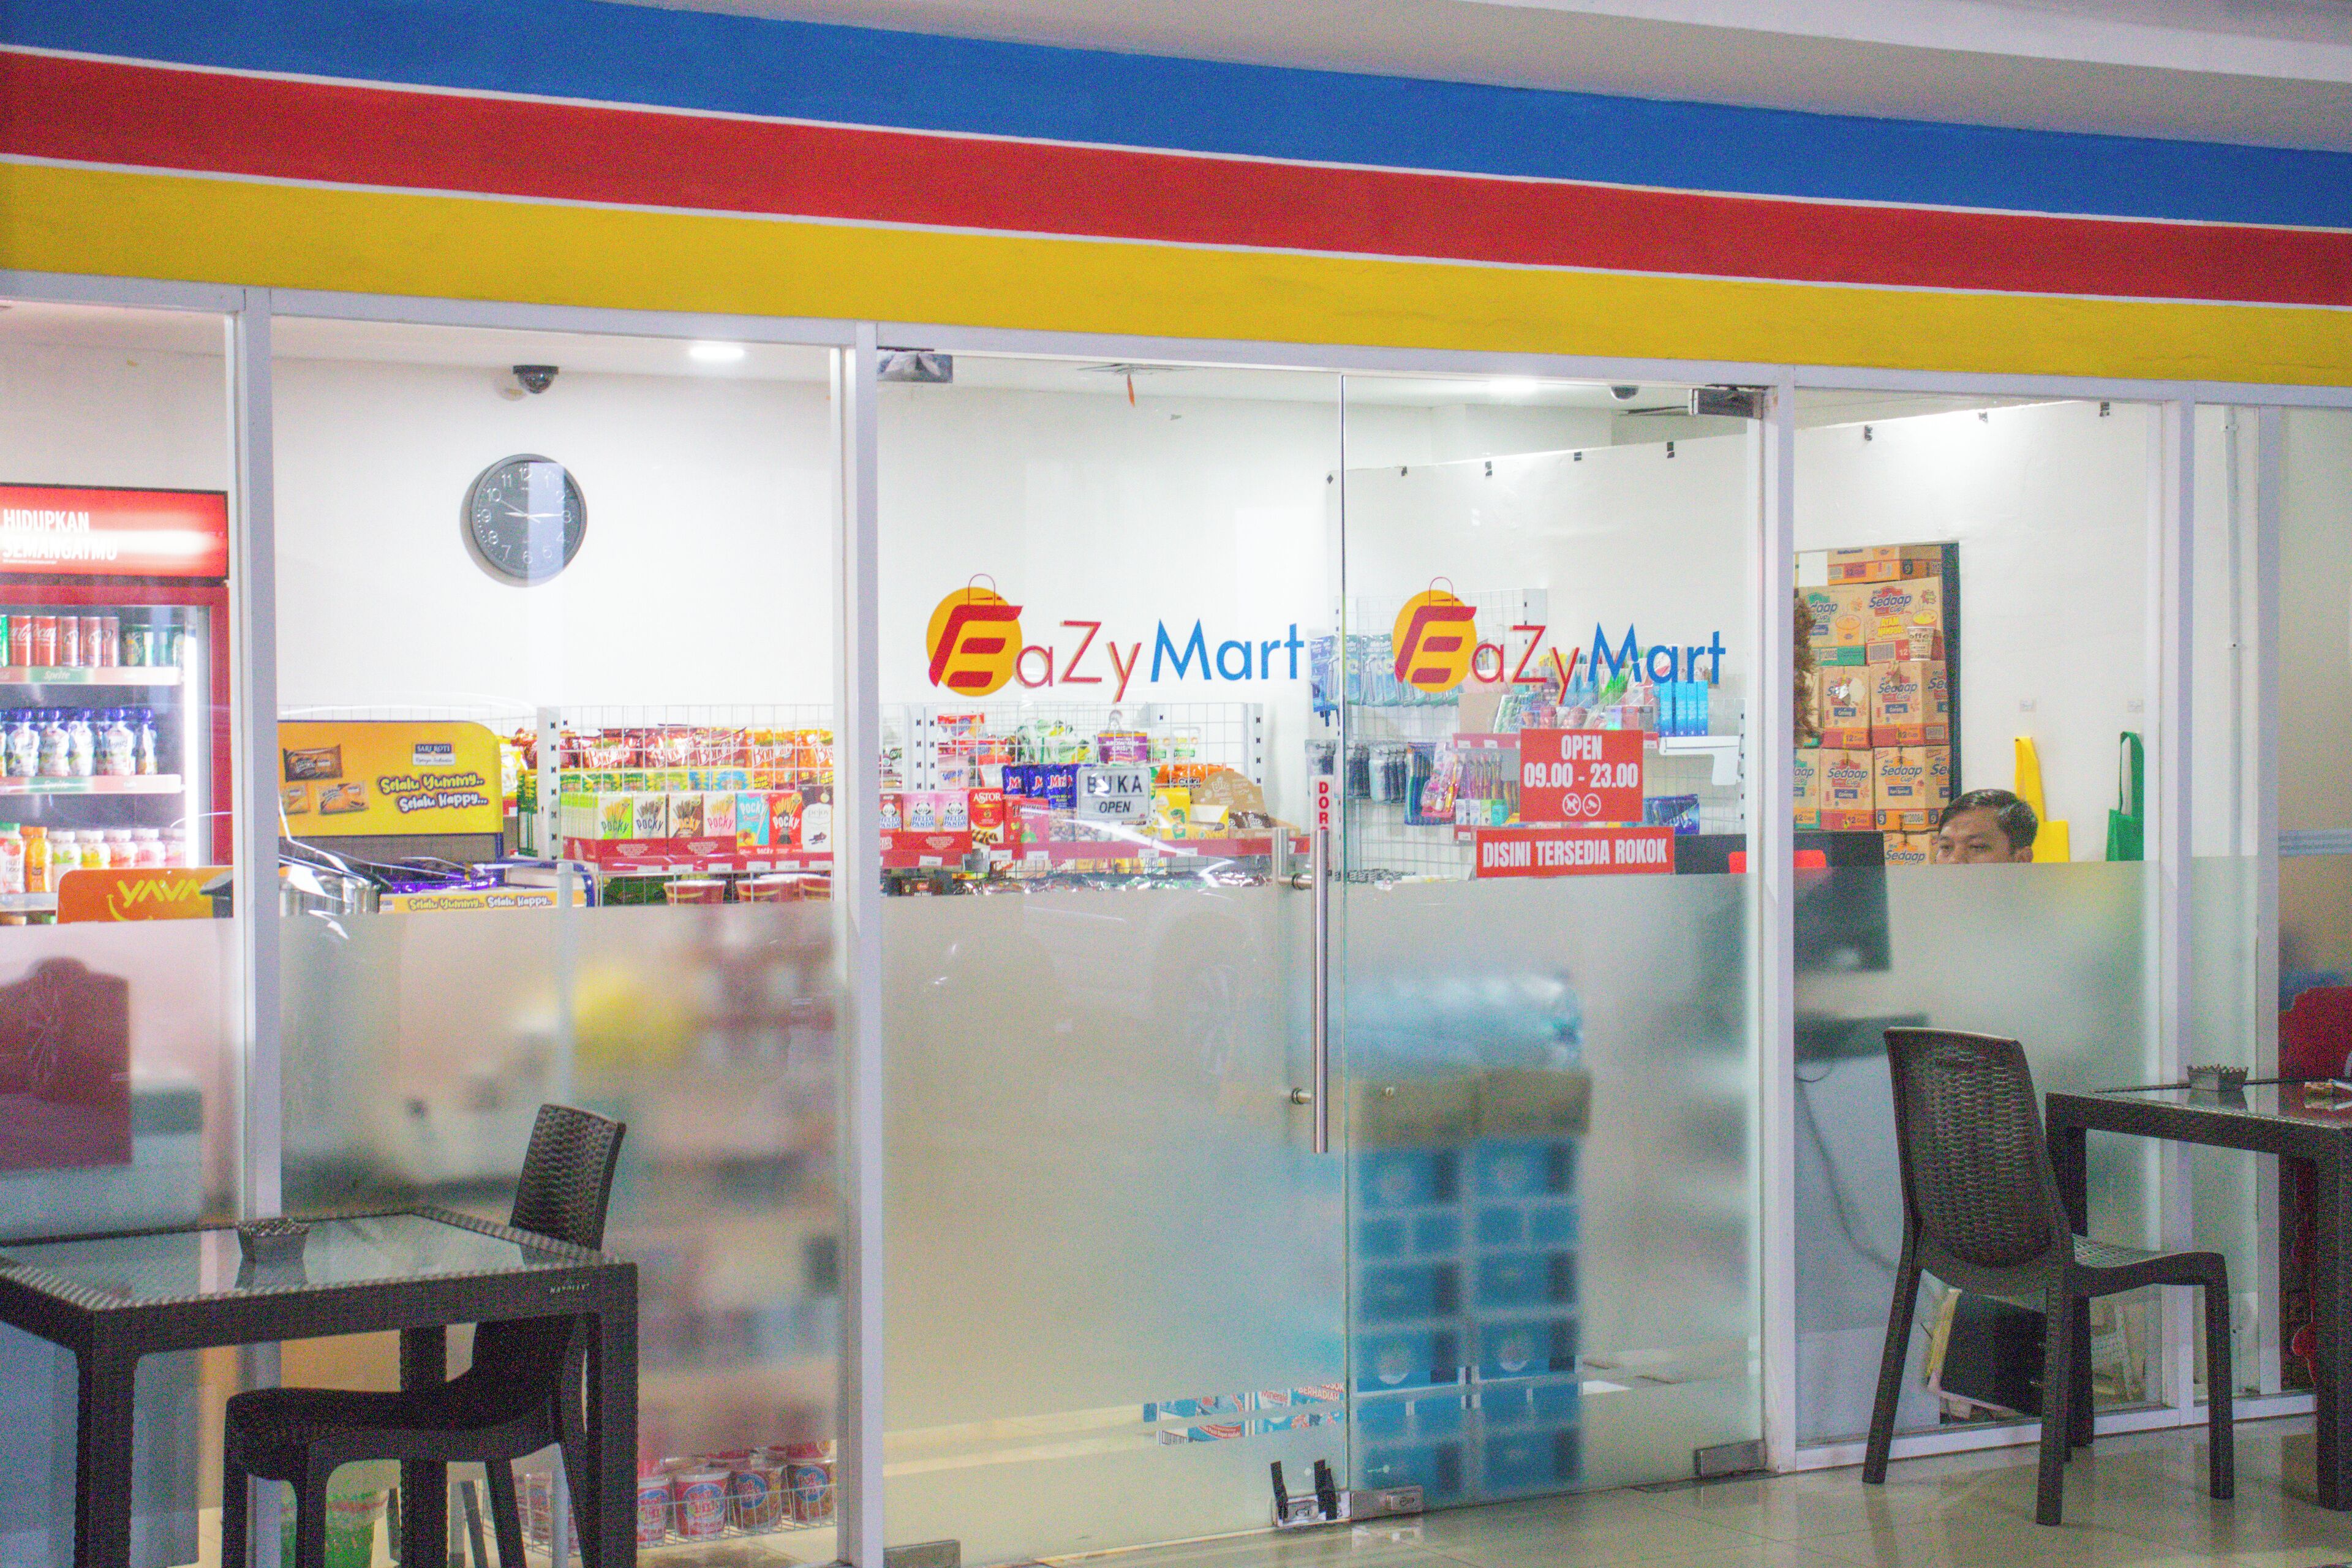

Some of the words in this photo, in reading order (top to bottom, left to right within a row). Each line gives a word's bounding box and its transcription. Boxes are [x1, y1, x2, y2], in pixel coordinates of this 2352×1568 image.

[502, 474, 512, 488] 11
[487, 488, 501, 502] 10
[3, 509, 89, 533] HIDUPKAN
[481, 509, 491, 523] 9
[488, 530, 499, 545] 8
[502, 545, 511, 562] 7
[1869, 593, 1912, 608] Sedaap
[1561, 735, 1602, 760] OPEN
[1524, 763, 1573, 788] 09.00
[1590, 763, 1638, 788] 23.00
[1827, 766, 1868, 781] Sedaap
[1881, 764, 1923, 778] Sedaap
[380, 776, 421, 794] Selalu
[1087, 775, 1142, 794] BUKA
[399, 795, 435, 812] Selalu
[974, 792, 1001, 804] ASTOR
[1319, 781, 1329, 830] DOR
[1099, 801, 1131, 813] OPEN
[1483, 842, 1531, 868] DISINI
[1536, 839, 1610, 866] TERSEDIA
[1615, 838, 1667, 864] ROKOK
[1886, 849, 1926, 863] Sedaap
[409, 899, 438, 911] Selalu
[487, 896, 514, 908] Selalu
[1298, 1386, 1340, 1402] BERHADIAH
